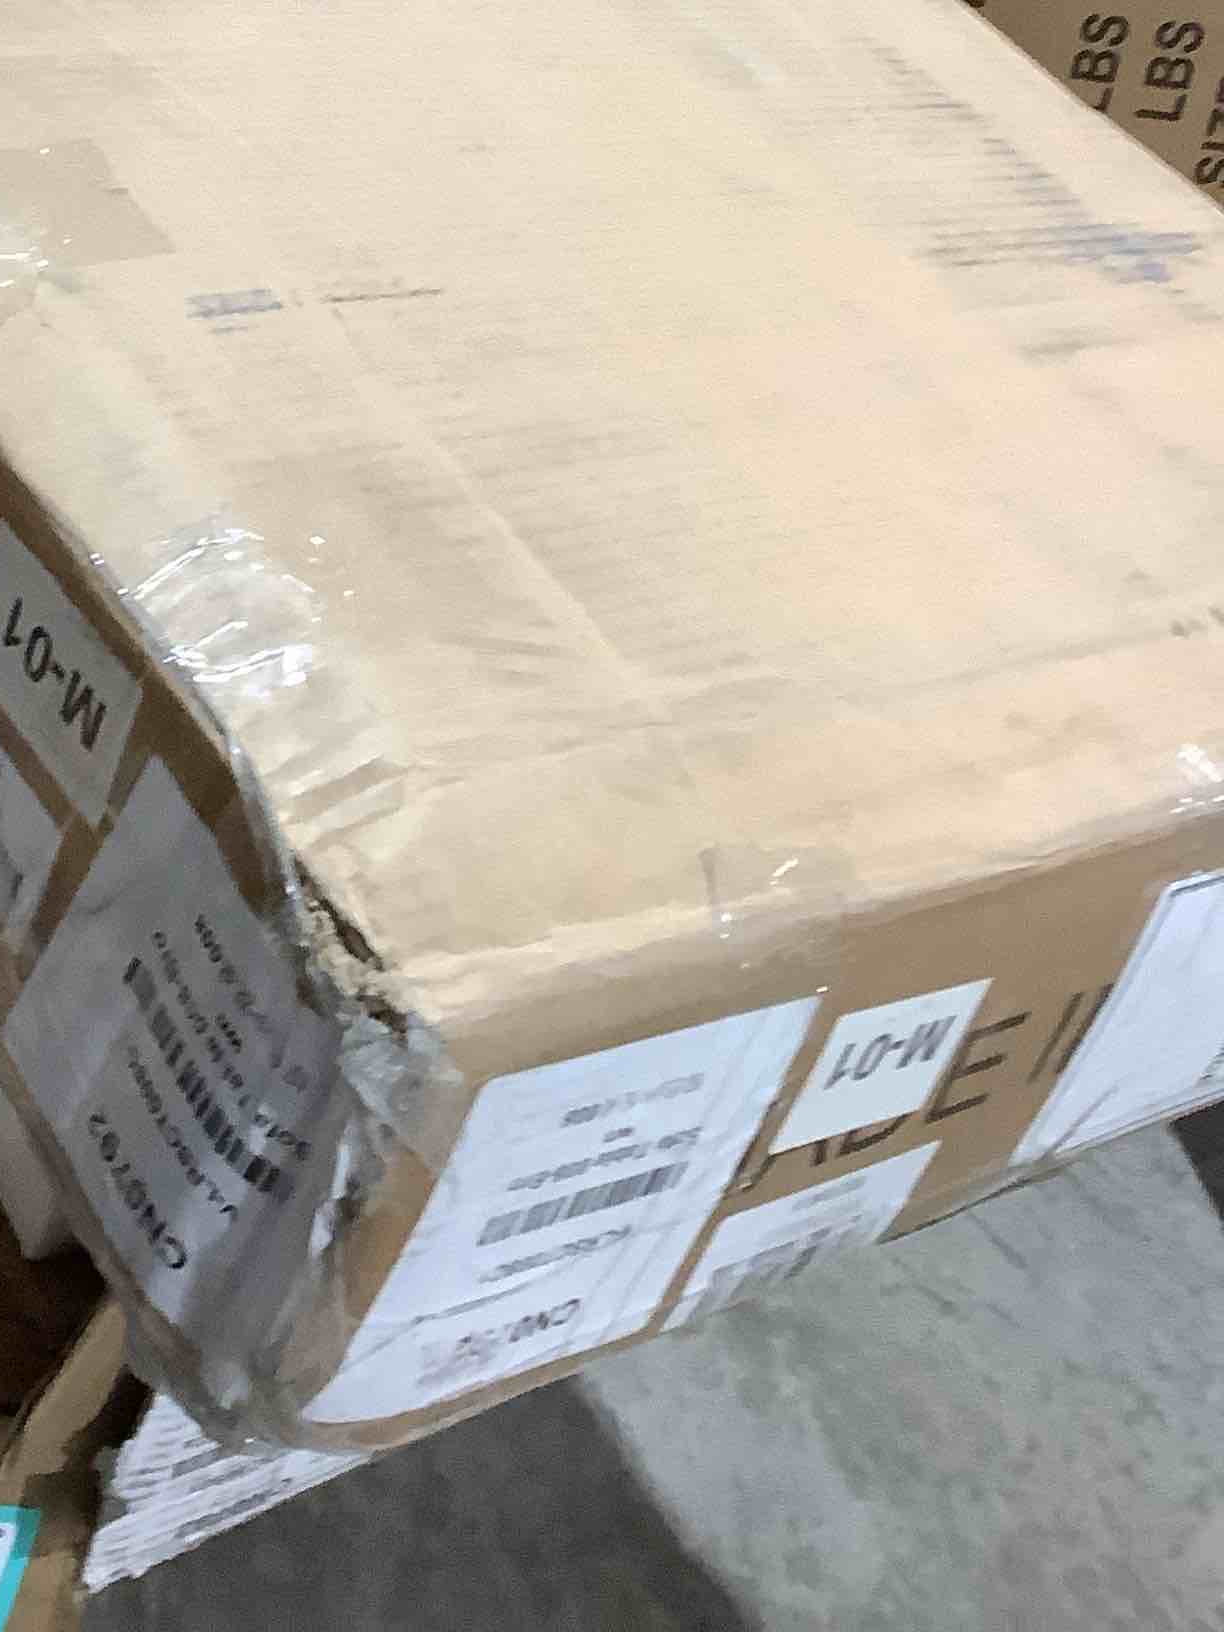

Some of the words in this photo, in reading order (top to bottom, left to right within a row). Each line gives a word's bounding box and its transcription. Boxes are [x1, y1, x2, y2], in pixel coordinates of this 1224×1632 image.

[1132, 19, 1206, 123] LBS
[2, 596, 108, 753] M-01
[823, 1014, 959, 1091] M-01
